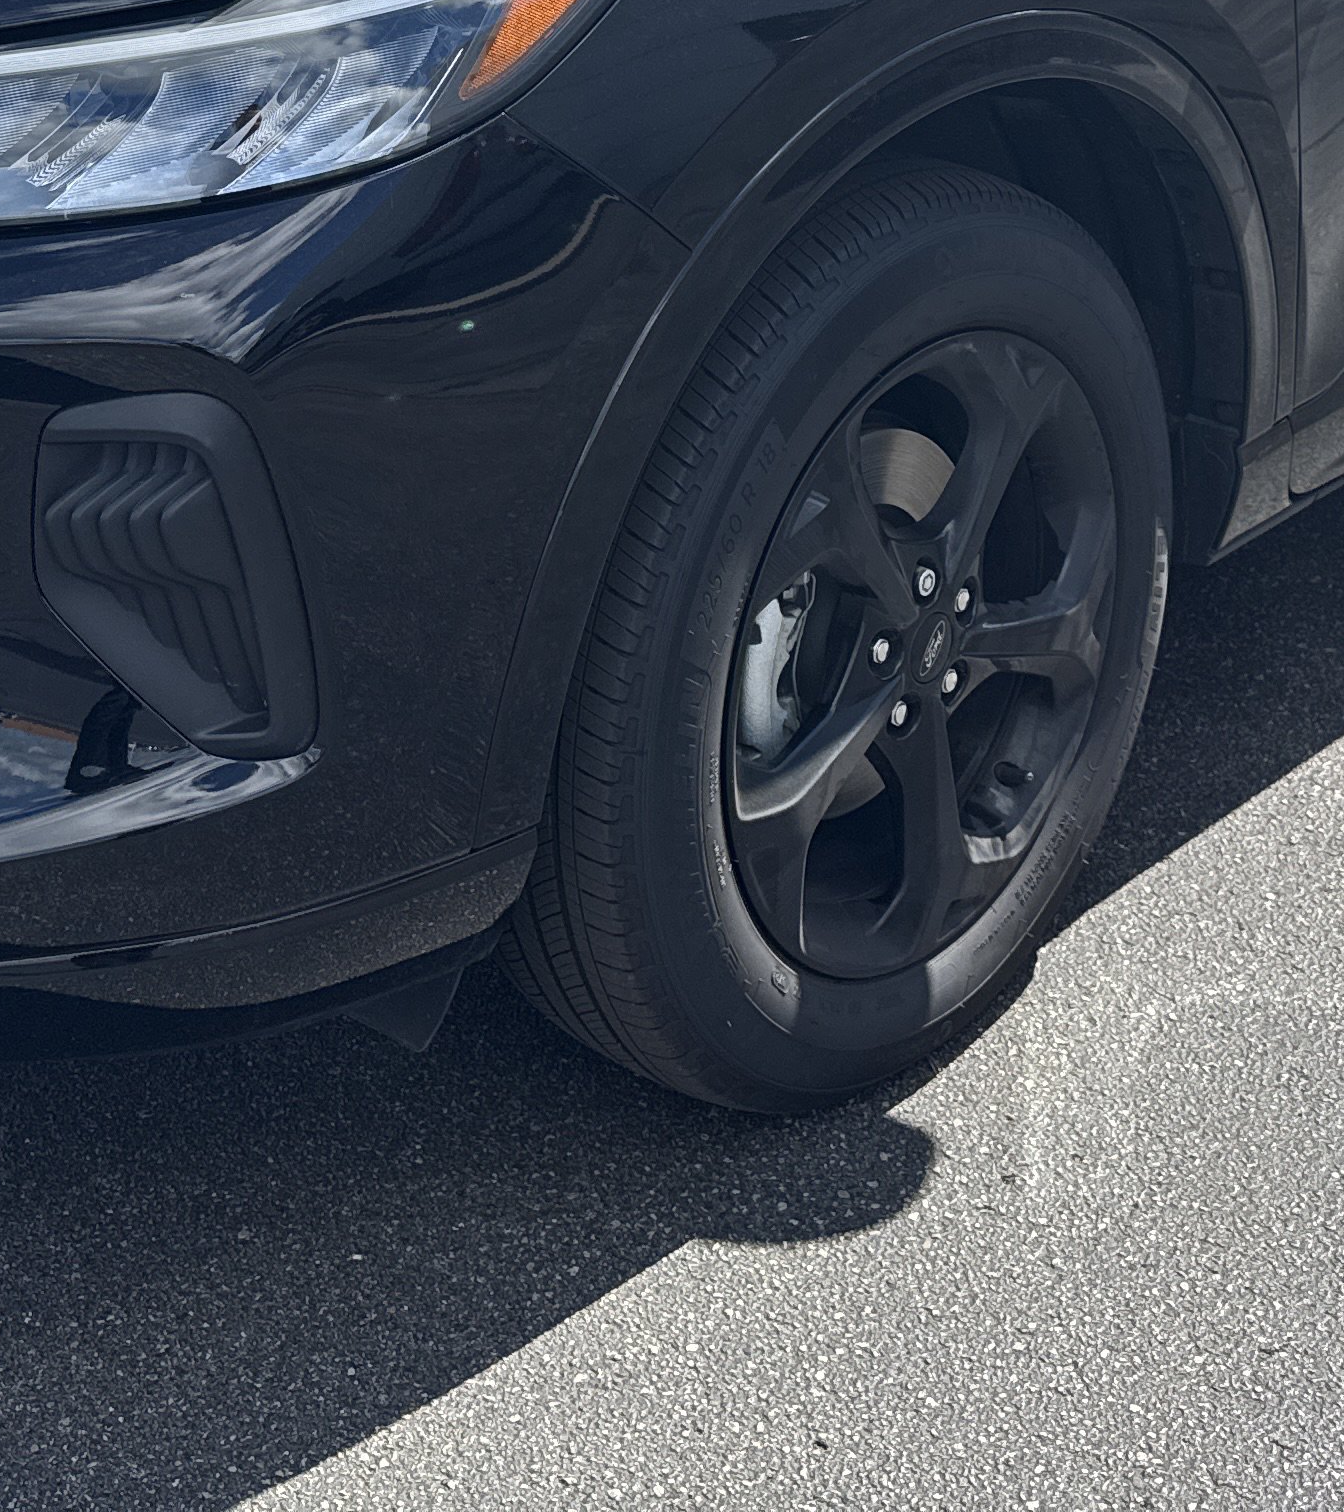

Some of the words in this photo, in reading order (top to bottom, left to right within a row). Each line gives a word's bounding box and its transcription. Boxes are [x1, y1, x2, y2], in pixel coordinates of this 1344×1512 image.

[697, 514, 743, 631] 225/60
[741, 482, 756, 507] R
[757, 442, 777, 474] 18
[924, 629, 944, 668] Ford
